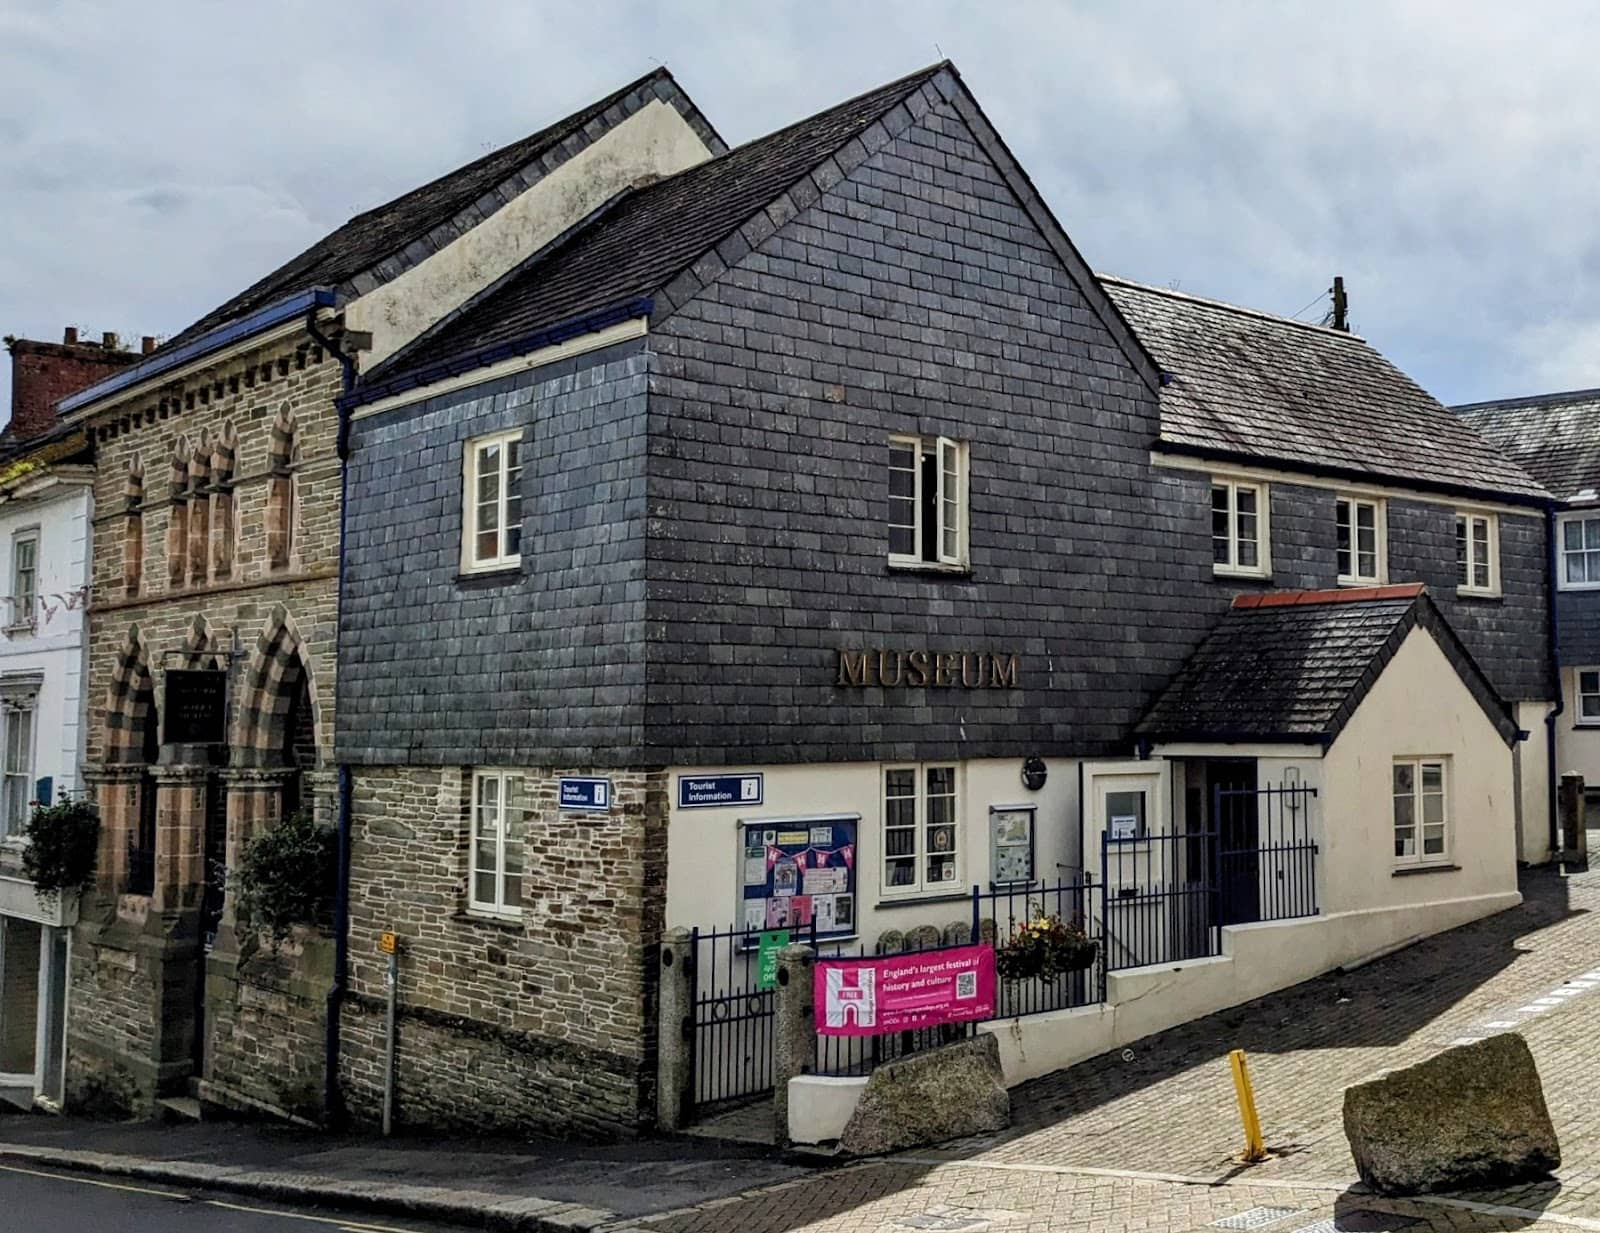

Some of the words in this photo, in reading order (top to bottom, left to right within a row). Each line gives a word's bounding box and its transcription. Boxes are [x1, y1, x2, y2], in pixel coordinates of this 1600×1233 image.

[837, 649, 1021, 688] MUSEUM
[563, 784, 579, 793] Tourist
[688, 781, 716, 791] Tourist
[562, 793, 588, 802] Information
[688, 791, 732, 801] Information
[883, 966, 919, 980] England's
[919, 963, 945, 974] largest
[945, 959, 972, 970] festival
[882, 981, 910, 992] history
[911, 978, 926, 988] and
[926, 975, 953, 986] culture
